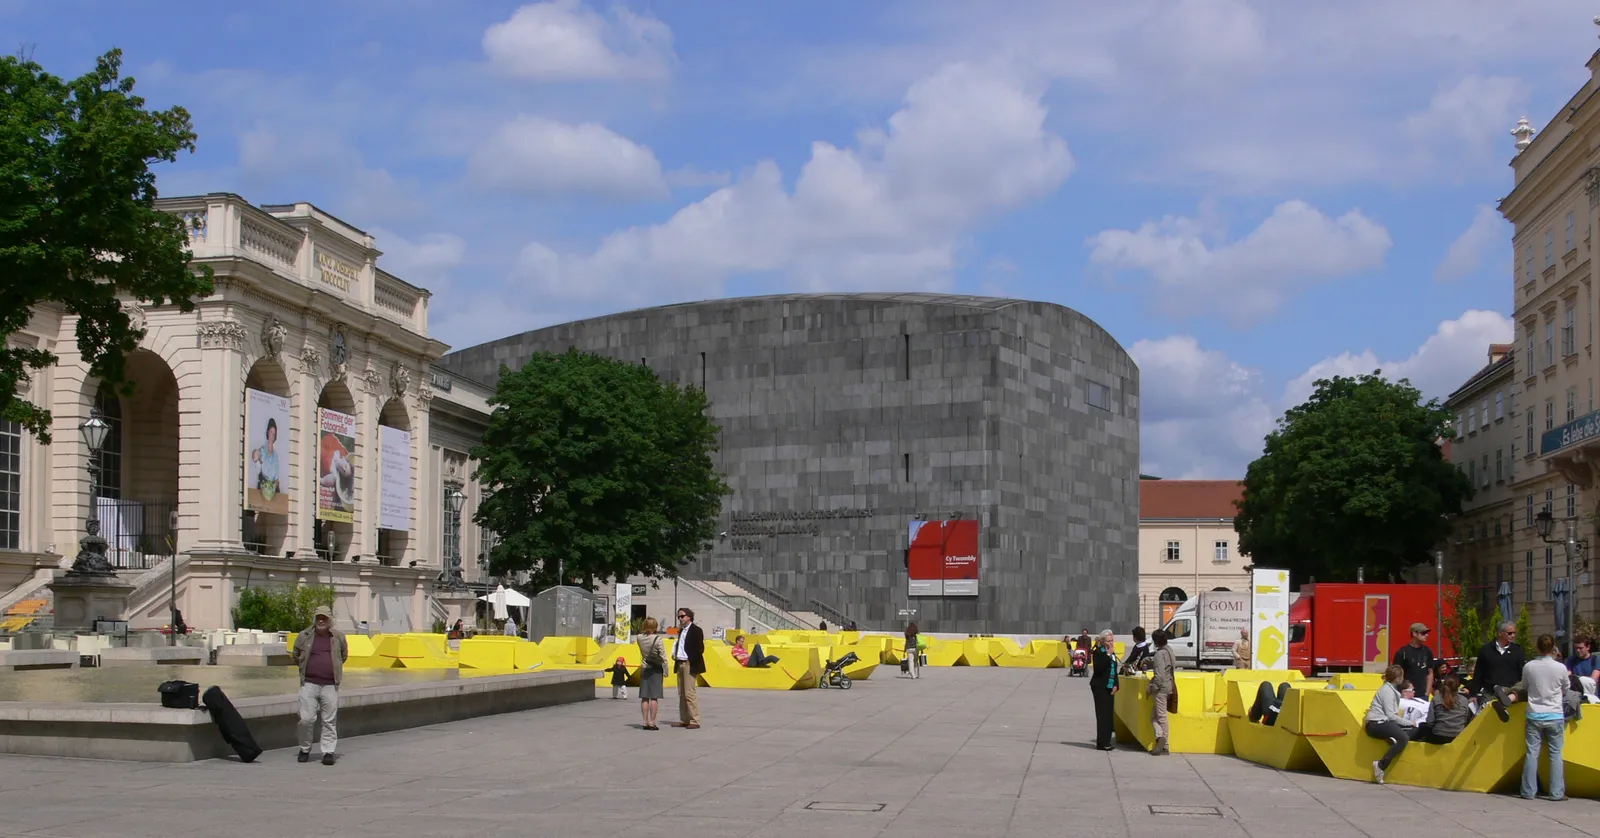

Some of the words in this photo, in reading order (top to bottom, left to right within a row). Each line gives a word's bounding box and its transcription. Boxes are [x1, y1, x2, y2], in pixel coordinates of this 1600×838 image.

[321, 409, 344, 423] Sommer
[344, 415, 353, 426] der
[321, 419, 348, 435] Fotografie
[1562, 428, 1571, 446] Es
[1571, 422, 1584, 443] lebe
[1584, 418, 1594, 438] die
[731, 510, 779, 522] Museum
[780, 508, 837, 521] Moderner
[838, 507, 874, 519] Kunst
[731, 523, 776, 538] Stiftung
[777, 522, 821, 537] Ludwig
[731, 539, 761, 551] Wien
[1209, 600, 1243, 611] GOMI
